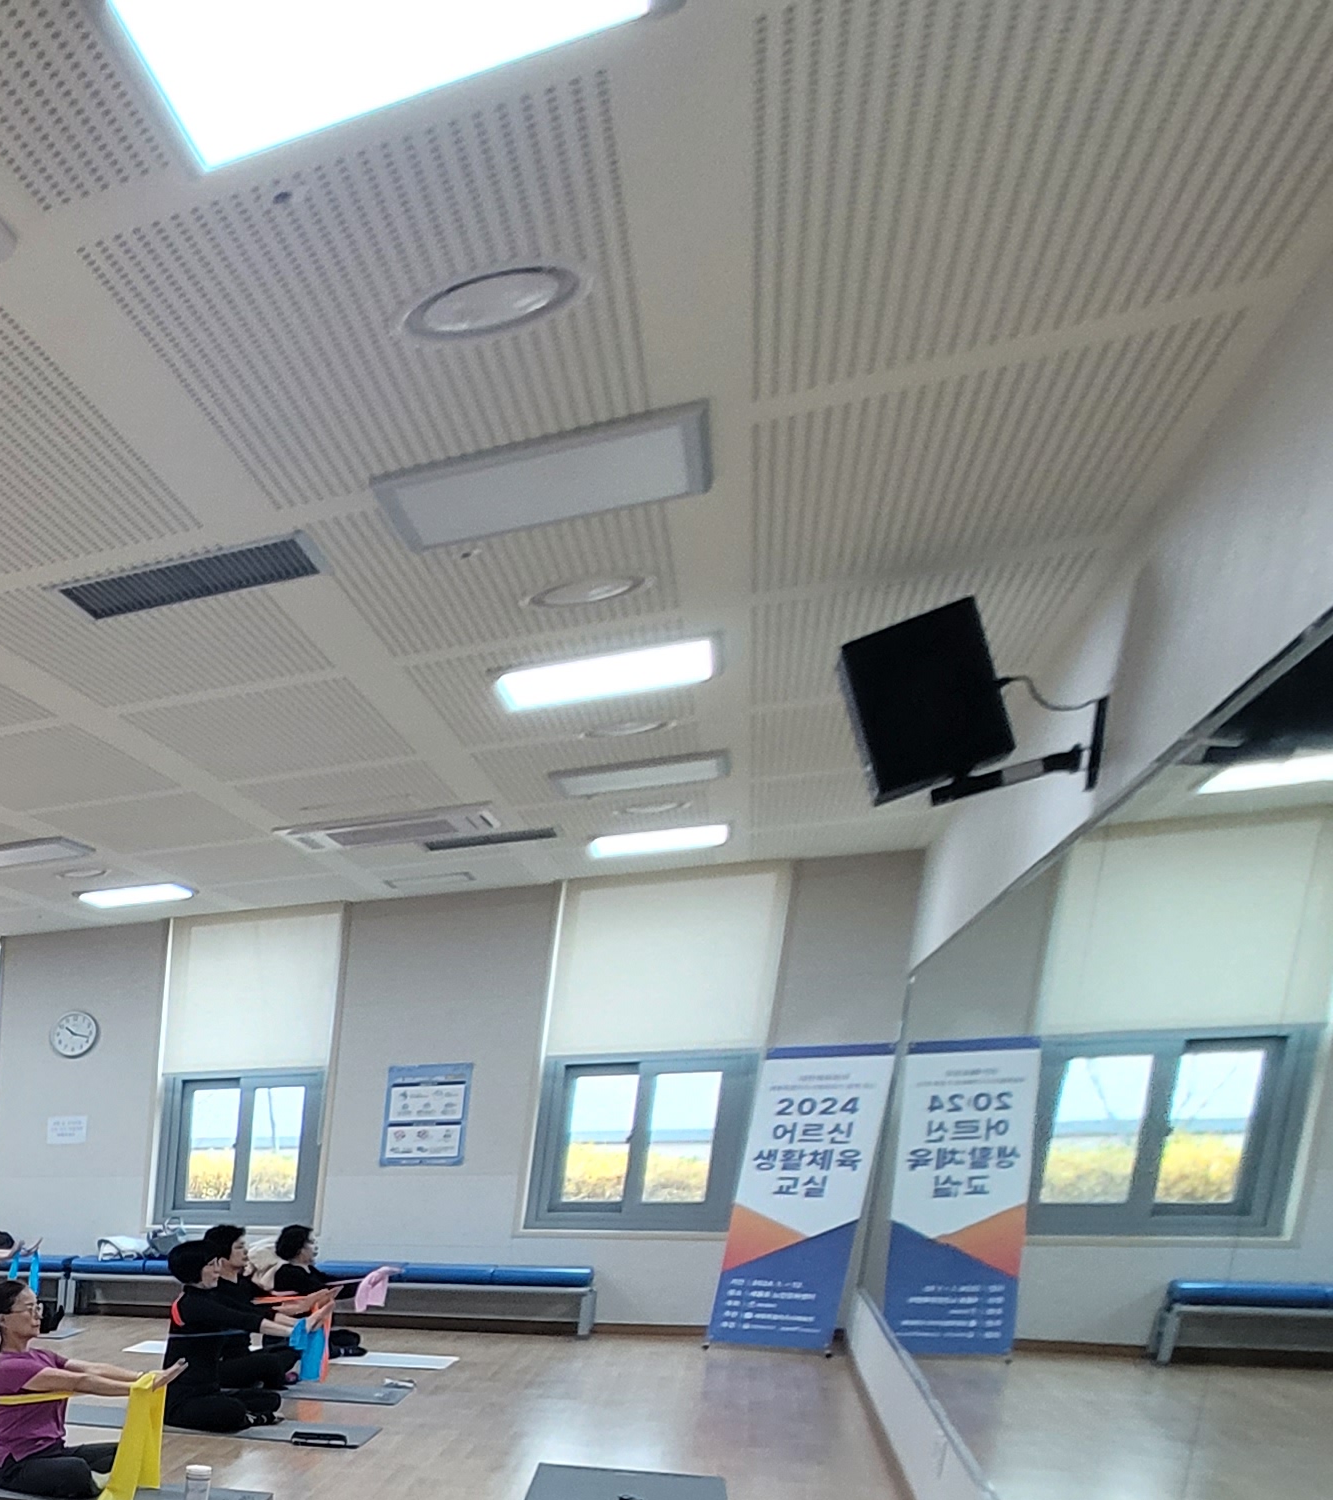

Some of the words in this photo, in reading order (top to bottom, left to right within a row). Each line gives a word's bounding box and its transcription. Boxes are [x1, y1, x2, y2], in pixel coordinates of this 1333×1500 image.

[775, 1096, 860, 1116] 2024
[773, 1121, 854, 1144] 어르신
[753, 1148, 862, 1172] 생활체육
[772, 1176, 827, 1198] 교실
